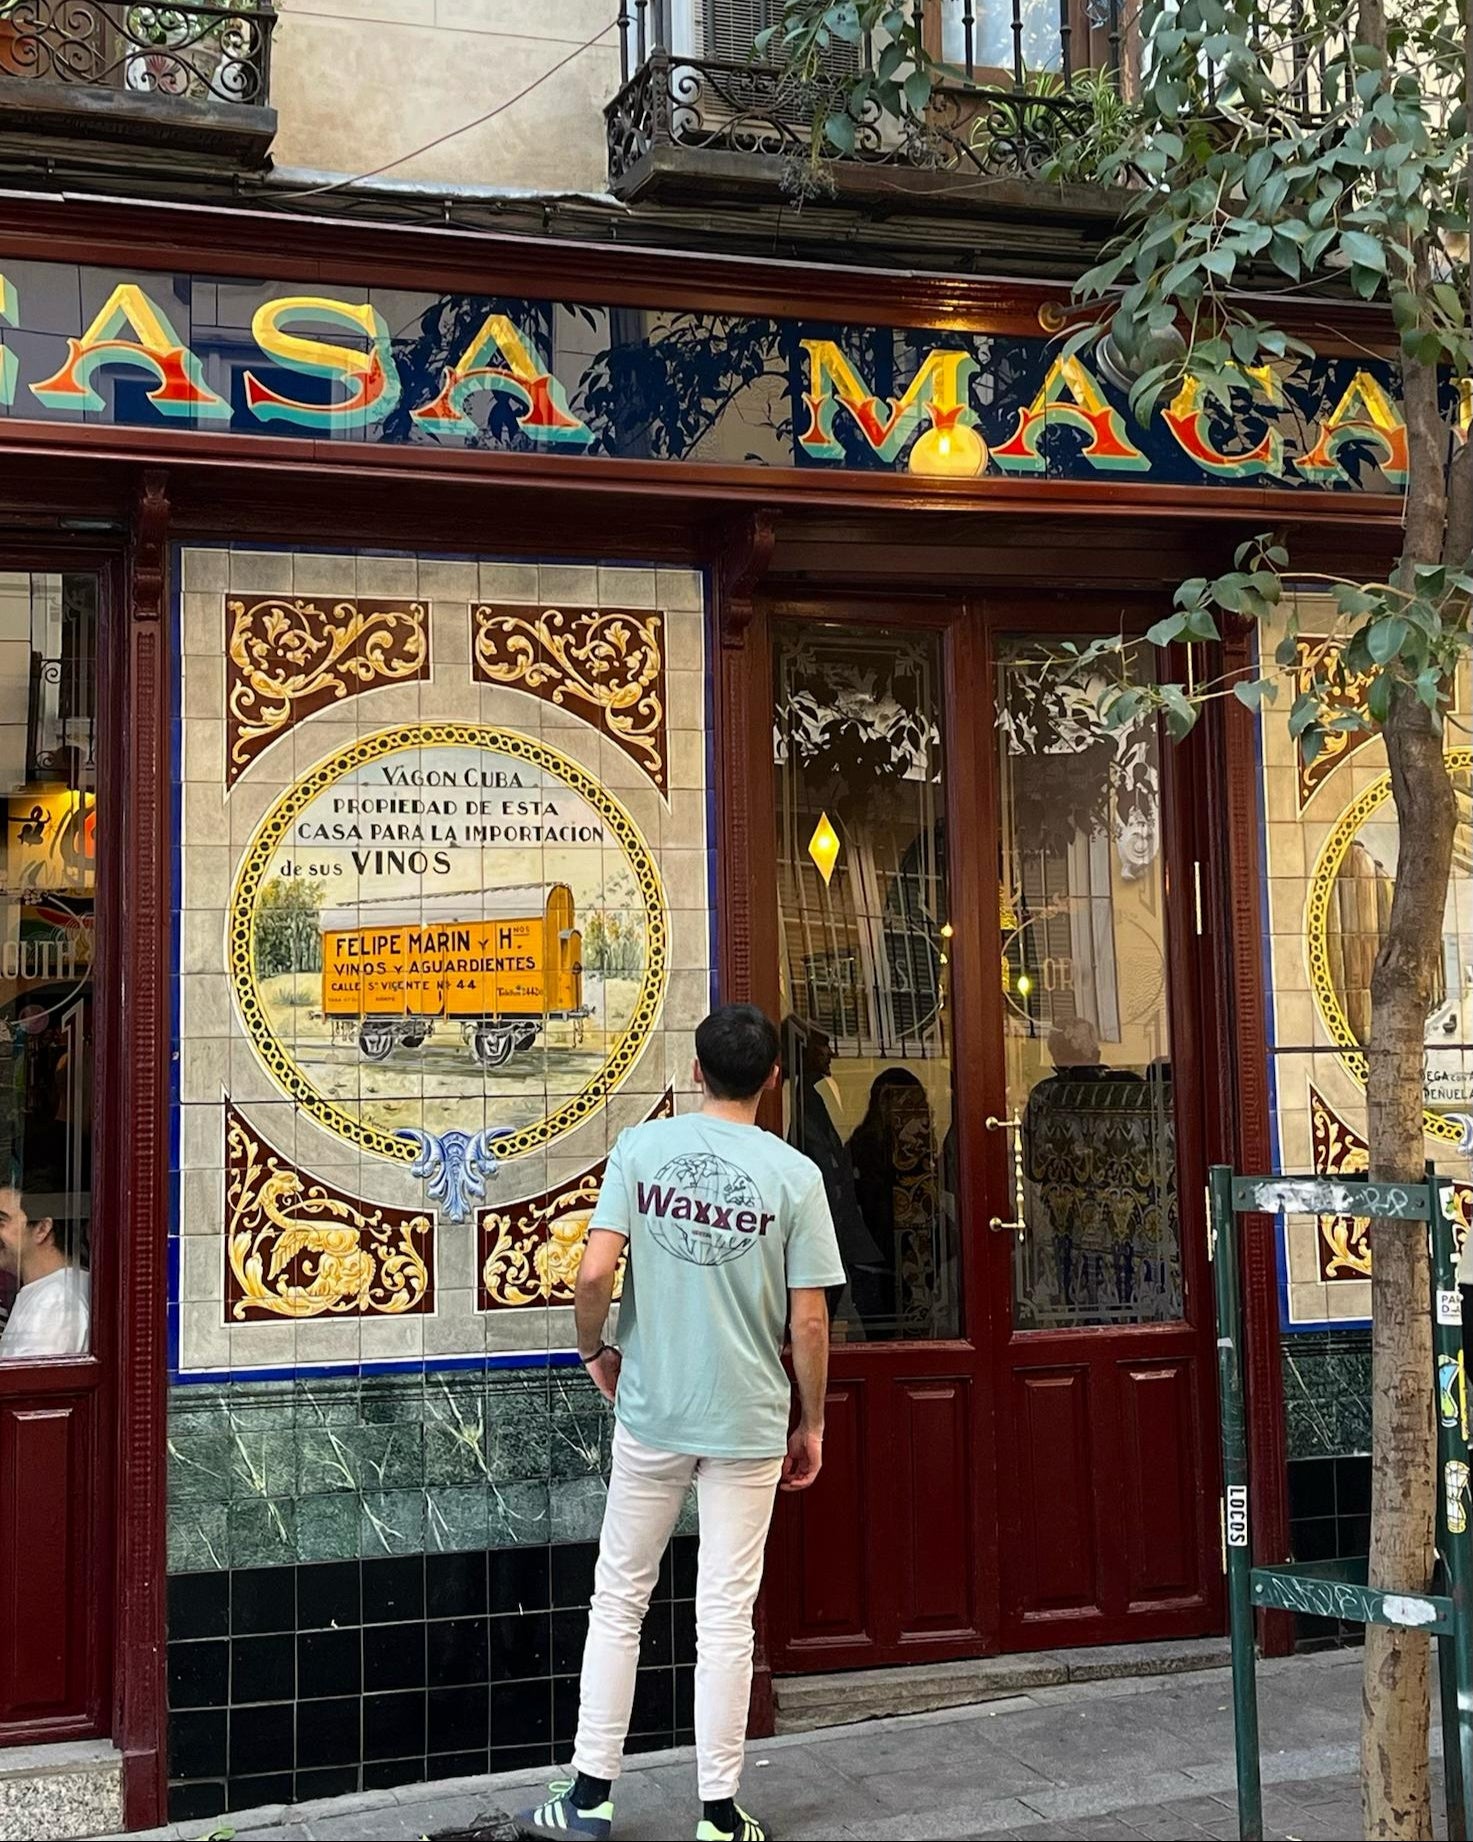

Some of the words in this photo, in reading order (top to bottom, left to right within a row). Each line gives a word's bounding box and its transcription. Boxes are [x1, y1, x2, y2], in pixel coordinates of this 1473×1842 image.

[0, 272, 597, 446] ASA
[799, 338, 1473, 486] MACA
[464, 768, 524, 789] CUBA
[333, 798, 458, 815] PROPIEDAD
[466, 801, 491, 816] DE
[502, 801, 559, 816] ESTA
[299, 823, 363, 841] CASA
[371, 824, 425, 841] PARA
[432, 825, 459, 842] LA
[280, 860, 303, 877] de
[309, 864, 344, 876] sus
[352, 850, 452, 876] VINOS
[337, 935, 401, 957] FELIPE
[409, 931, 470, 954] MARIN
[0, 940, 76, 980] OUTH
[334, 963, 386, 976] VINOS
[409, 956, 536, 973] AGUARDIENTES
[331, 982, 361, 991] CALLE
[456, 979, 477, 990] 44
[1423, 1070, 1448, 1082] EGA
[637, 1181, 776, 1236] Waxxer
[1229, 1487, 1245, 1543] LOCOS
